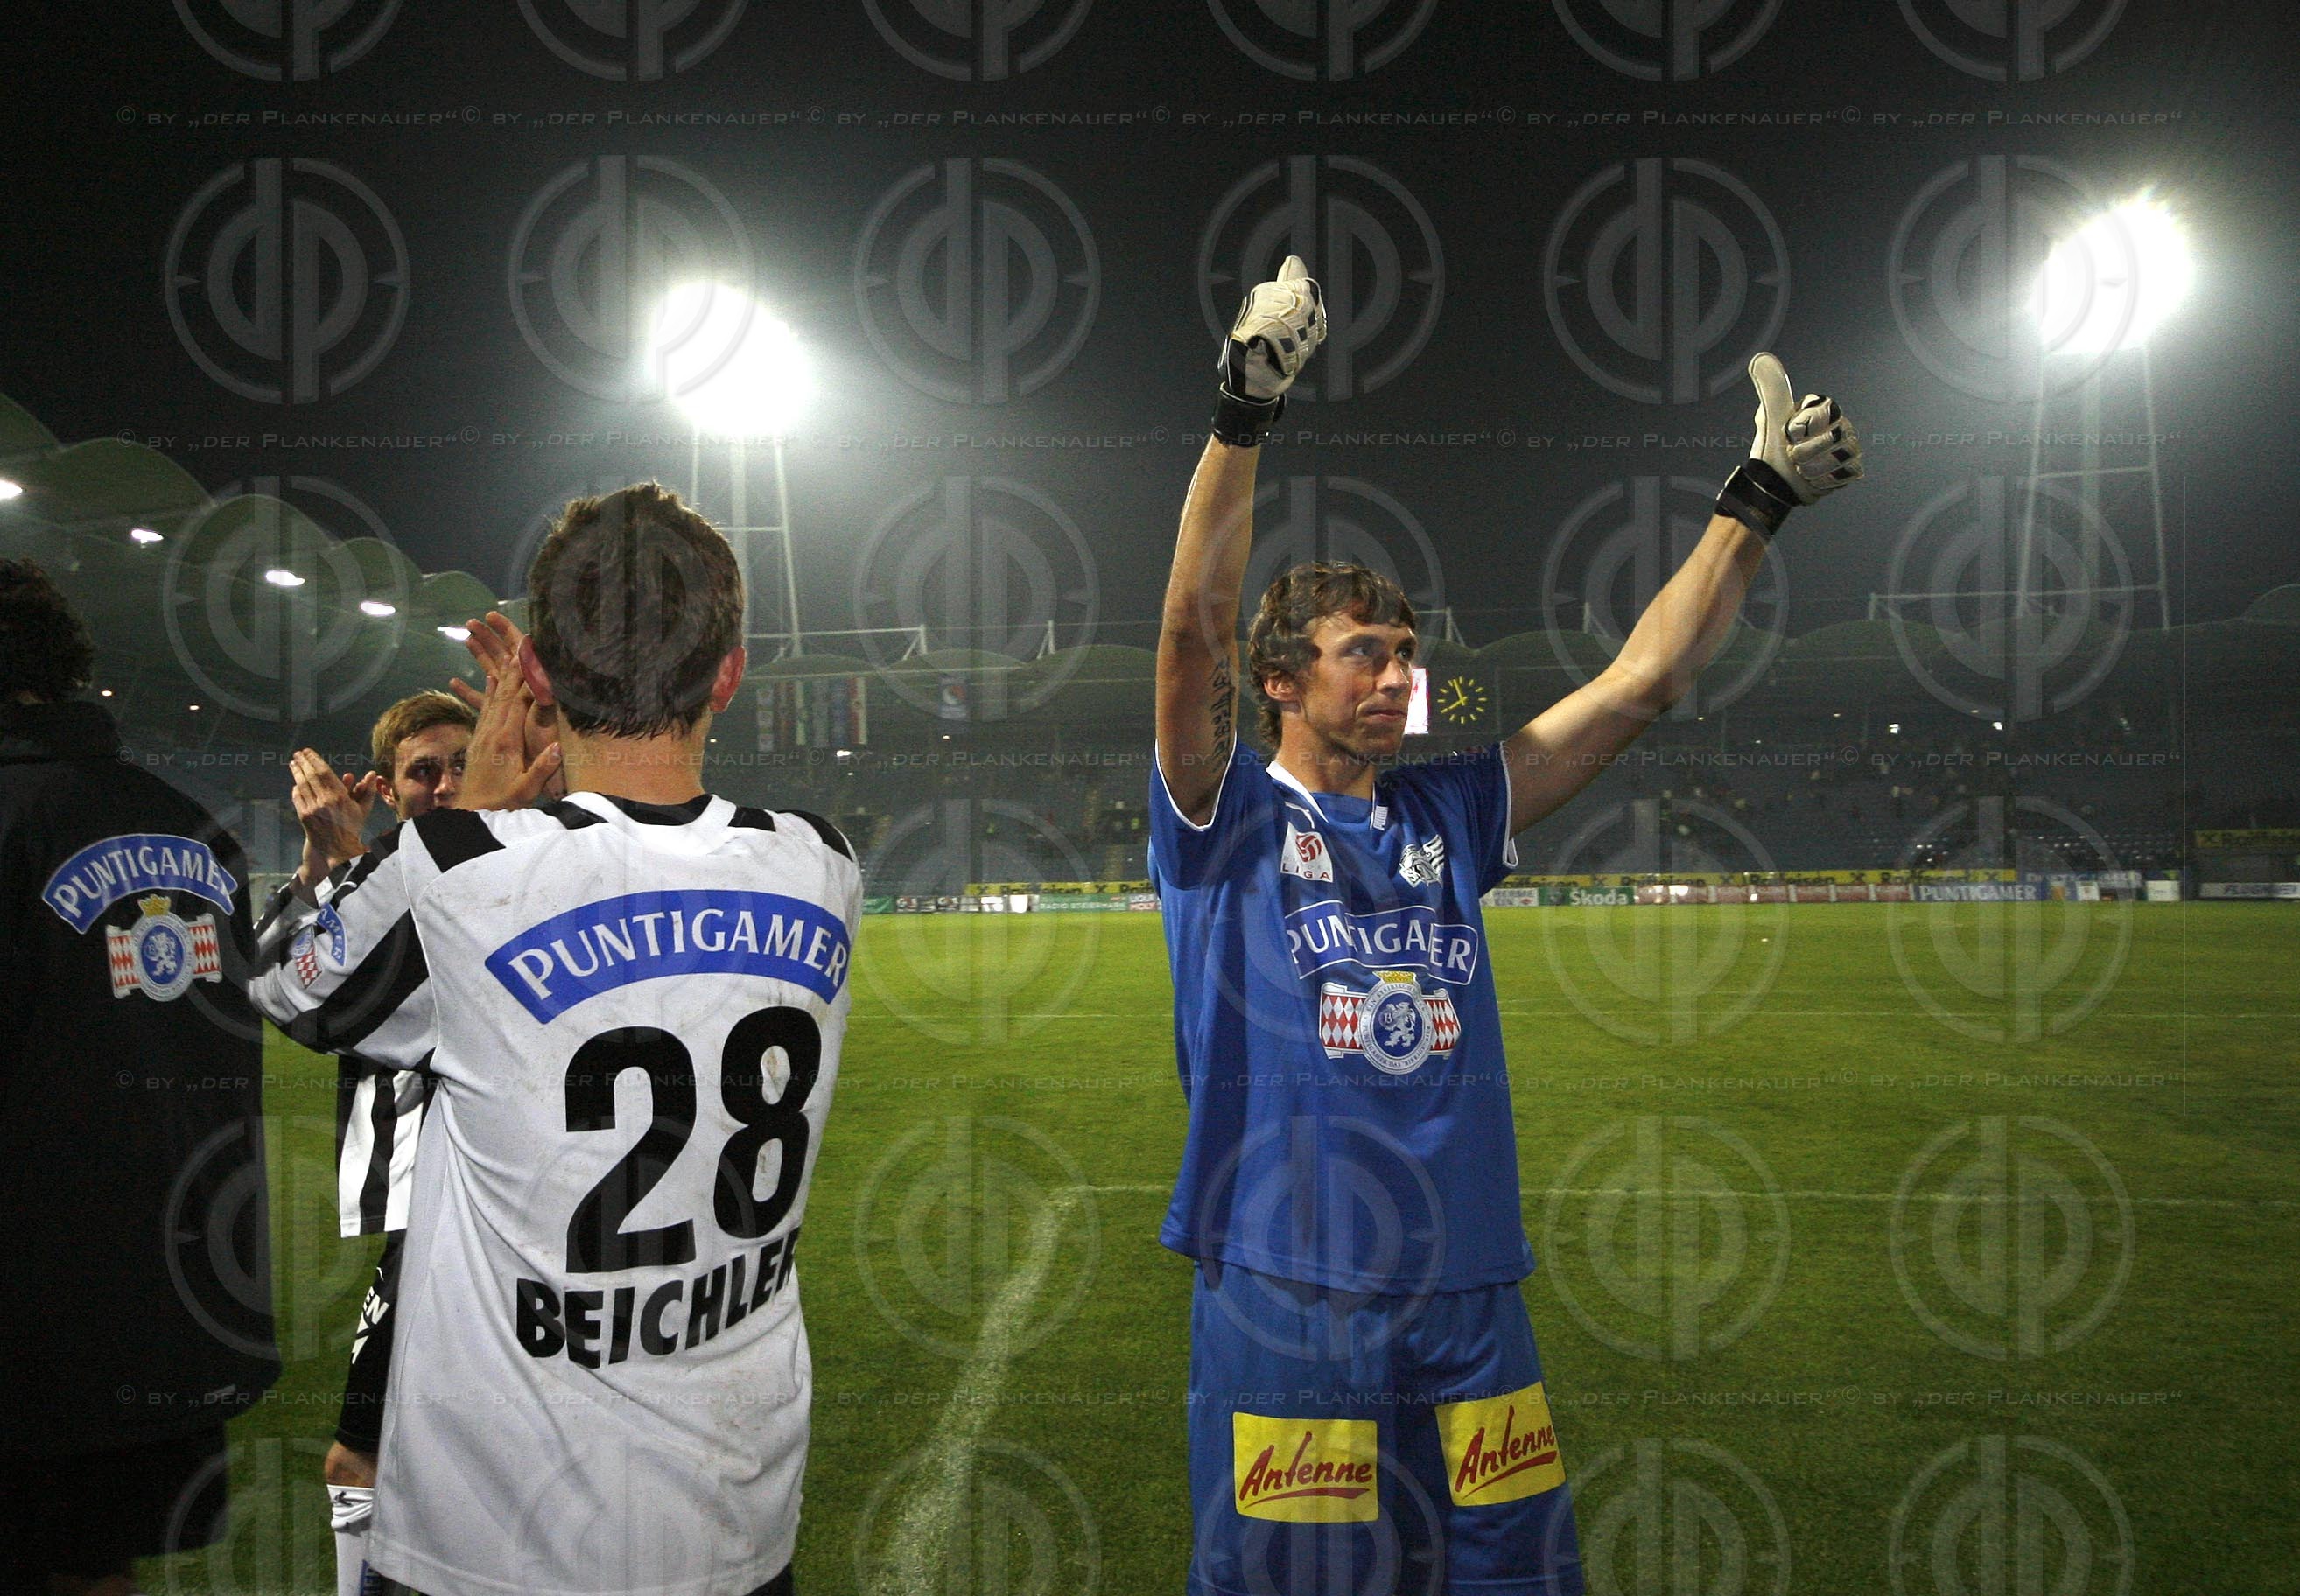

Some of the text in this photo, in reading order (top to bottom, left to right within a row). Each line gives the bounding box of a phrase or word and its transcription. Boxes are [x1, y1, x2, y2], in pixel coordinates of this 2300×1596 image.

[1281, 862, 1330, 881] LIGA
[1569, 887, 1630, 906] Škoda
[1918, 884, 2037, 902] PUNTIGAMER
[508, 908, 848, 1000] PUNTIGAMER
[564, 1005, 822, 1274] 28
[1239, 1431, 1373, 1501] Antenne
[1455, 1404, 1555, 1493] Antenne
